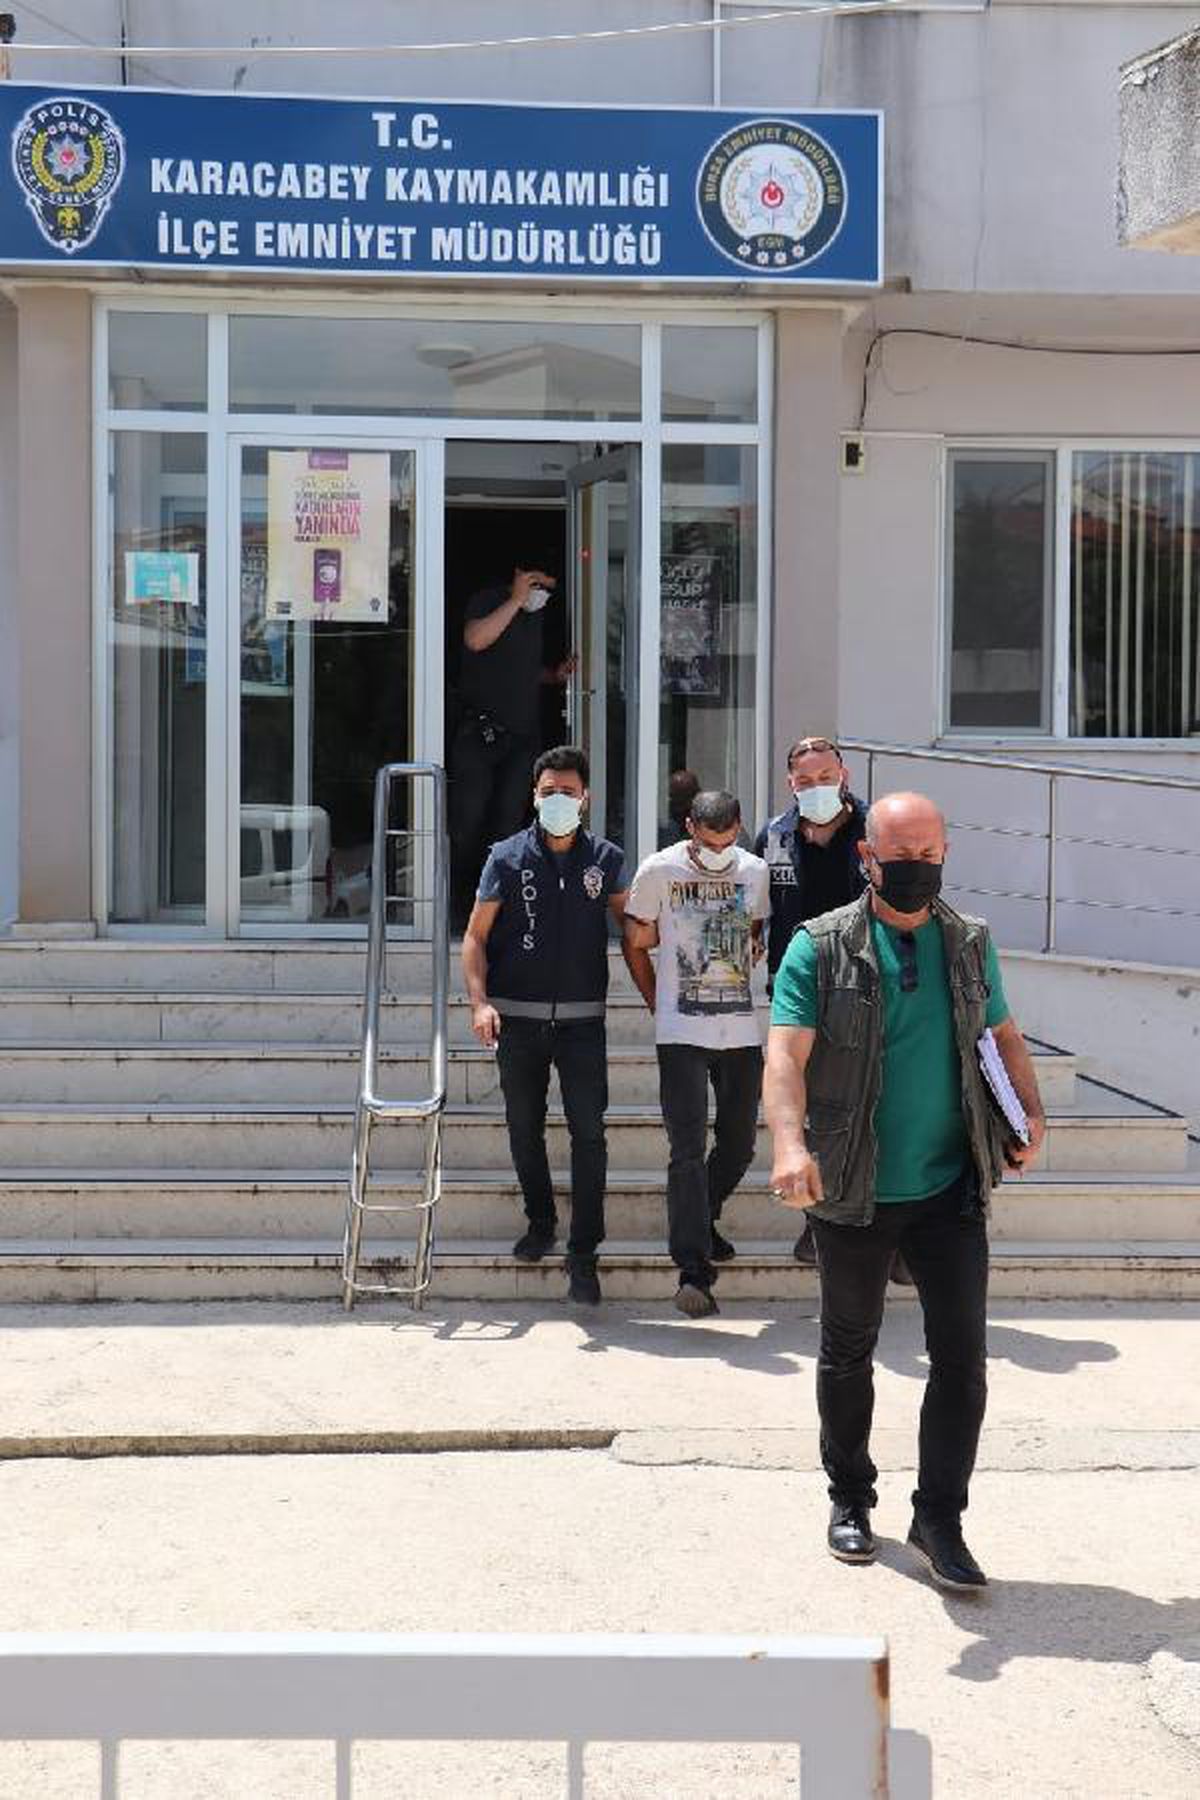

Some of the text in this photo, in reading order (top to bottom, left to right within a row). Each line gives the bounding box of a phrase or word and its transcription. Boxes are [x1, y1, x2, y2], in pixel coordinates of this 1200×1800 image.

[373, 113, 451, 149] T.C.
[152, 159, 371, 200] KARACABEY
[386, 166, 668, 206] KAYMAKAMLIĞI
[159, 212, 660, 265] İLÇE EMNİYET MÜDÜRLÜĞÜ
[295, 514, 361, 535] YANINDA
